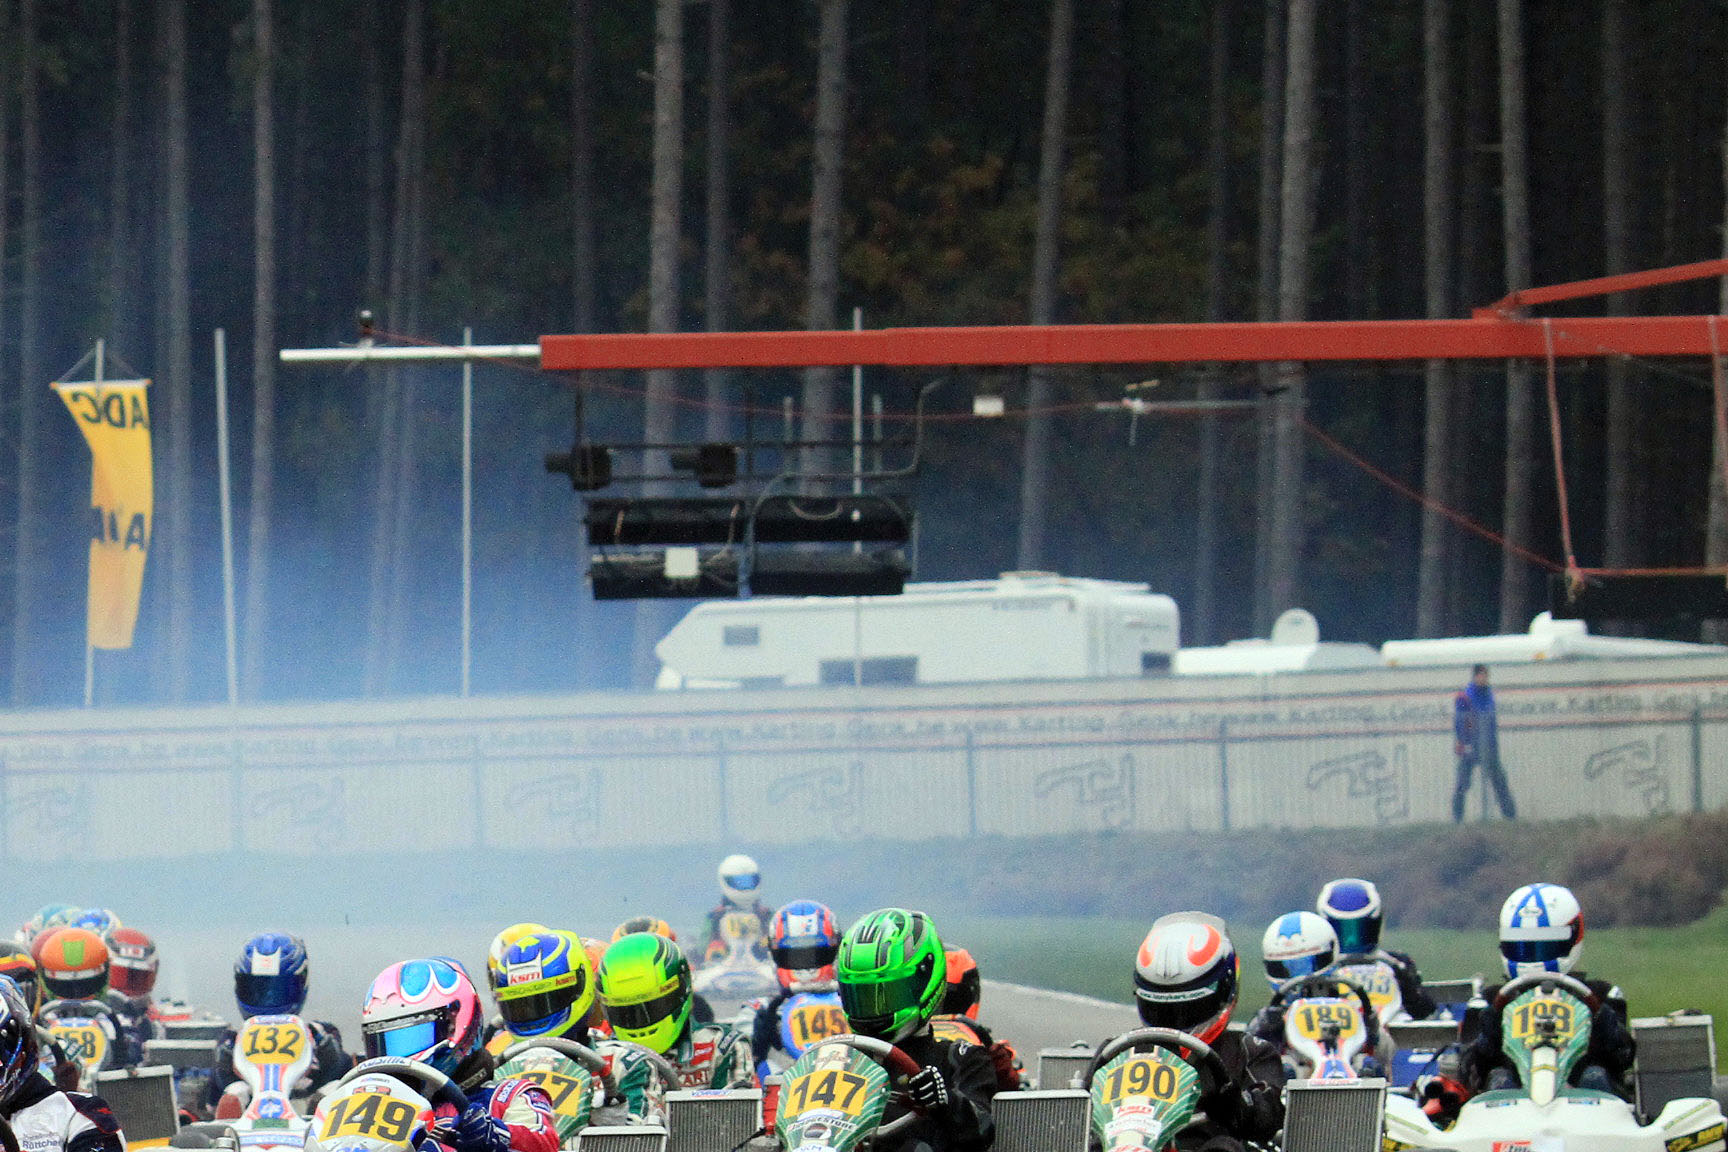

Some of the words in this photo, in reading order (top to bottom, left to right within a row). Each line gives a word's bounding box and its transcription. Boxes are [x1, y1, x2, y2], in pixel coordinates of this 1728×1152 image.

[510, 971, 541, 986] ksm
[245, 1027, 300, 1058] 132
[793, 1009, 846, 1041] 145
[794, 1072, 866, 1113] 147
[1107, 1061, 1177, 1100] 190
[327, 1095, 416, 1142] 149
